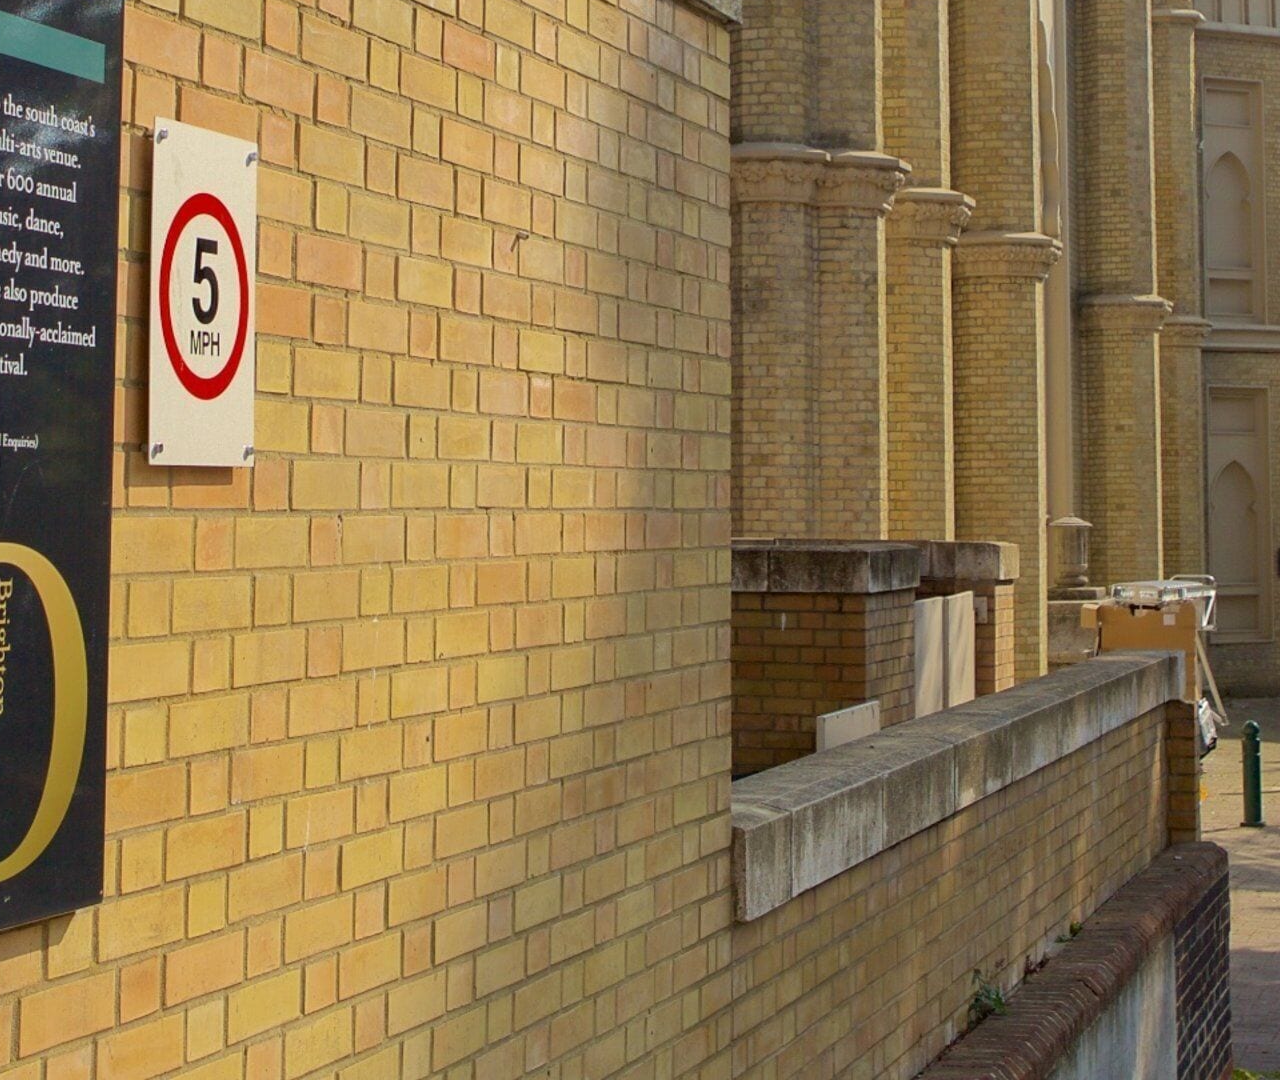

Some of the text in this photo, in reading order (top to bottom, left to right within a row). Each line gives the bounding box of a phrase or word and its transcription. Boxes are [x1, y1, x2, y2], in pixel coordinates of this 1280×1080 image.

[3, 93, 23, 119] the
[25, 104, 58, 128] south
[61, 116, 96, 138] coast's
[44, 147, 82, 169] venue.
[6, 167, 34, 193] 600
[36, 181, 77, 203] annual
[25, 208, 64, 239] dance,
[24, 247, 48, 270] and
[50, 256, 85, 276] more.
[3, 278, 27, 302] also
[30, 285, 79, 312] produce
[192, 237, 219, 325] 5
[190, 330, 220, 357] MPH
[3, 433, 39, 452] Enquiries)
